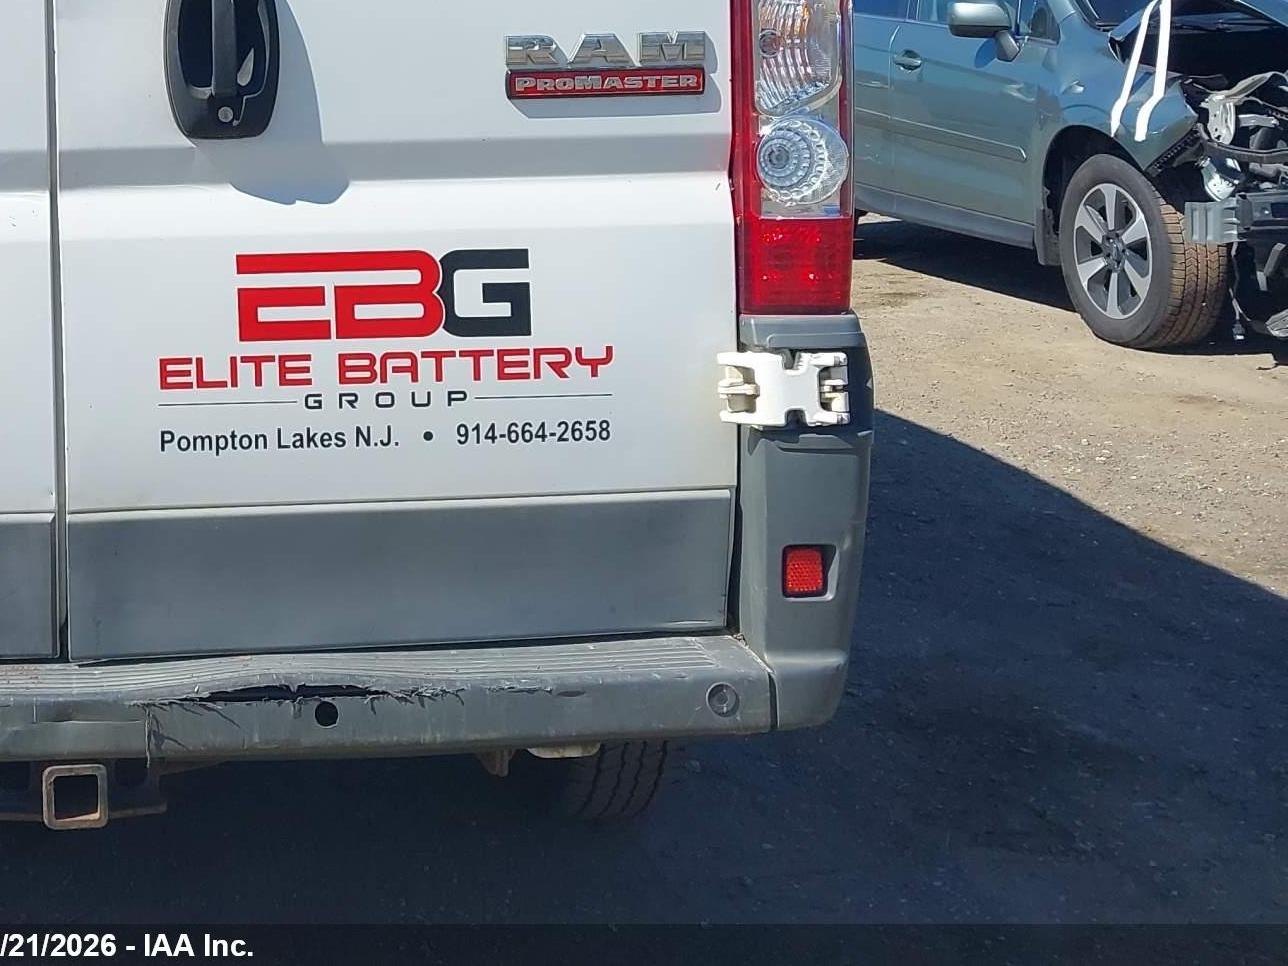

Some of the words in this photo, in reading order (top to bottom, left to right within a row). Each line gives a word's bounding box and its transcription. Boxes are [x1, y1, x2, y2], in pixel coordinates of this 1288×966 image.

[506, 31, 705, 66] RAM
[236, 248, 532, 342] EBG
[159, 354, 313, 390] ELITE
[337, 346, 614, 385] BATTERY
[304, 390, 468, 410] GROUP
[160, 430, 268, 456] Pompton
[277, 426, 347, 449] Lakes
[355, 425, 399, 448] N.J.
[456, 420, 611, 445] 914-664-2658
